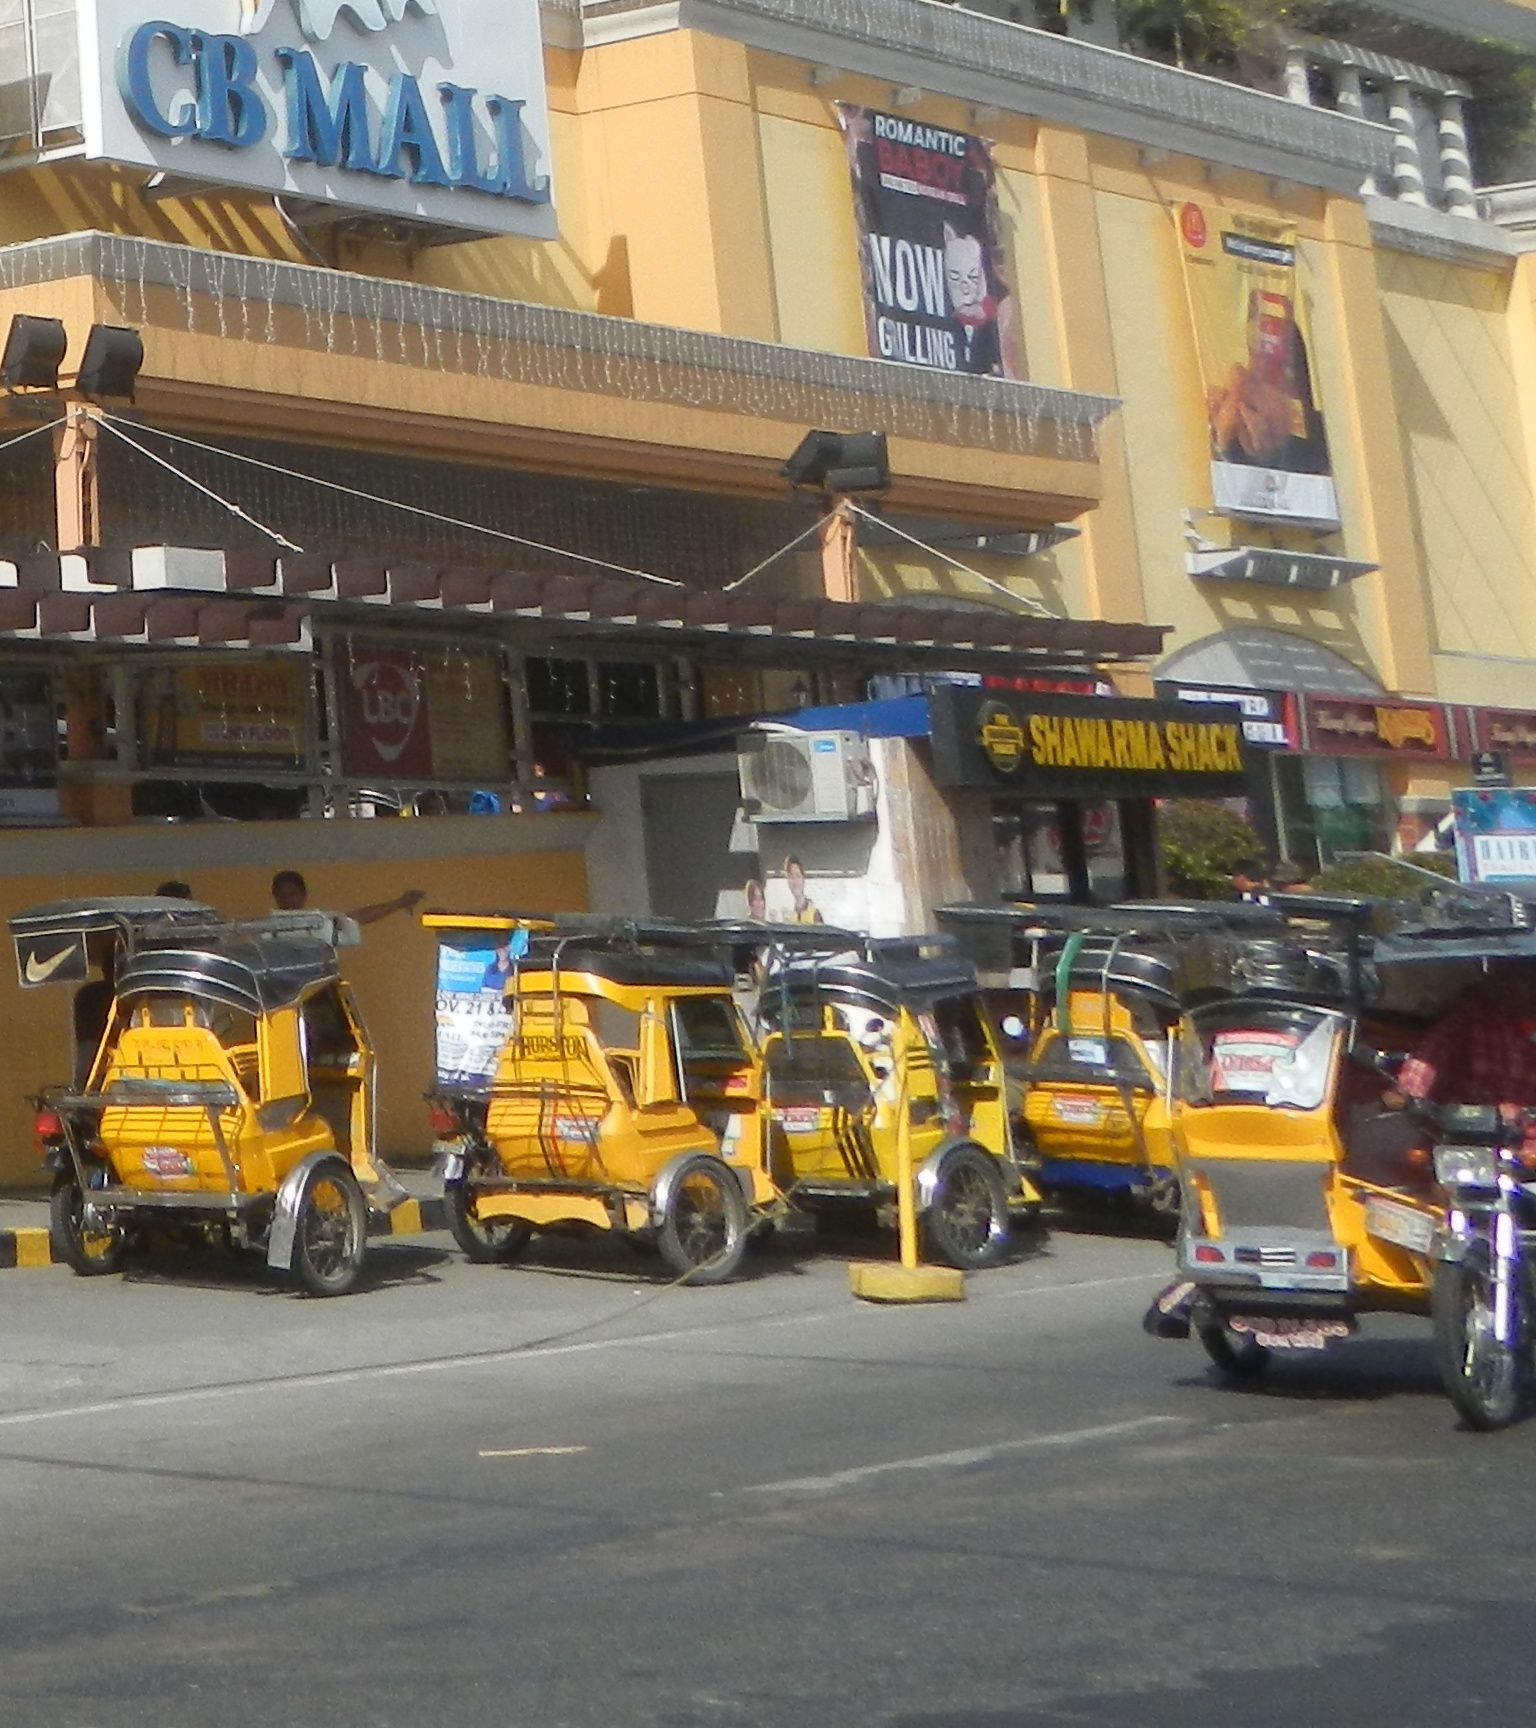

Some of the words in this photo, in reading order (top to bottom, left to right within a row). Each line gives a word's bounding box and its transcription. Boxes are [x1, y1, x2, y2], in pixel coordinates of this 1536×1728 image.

[115, 20, 267, 150] CB
[274, 47, 550, 205] MALL
[875, 114, 965, 157] ROMANTIC
[868, 232, 946, 317] NOW
[364, 690, 416, 724] LBC
[1029, 714, 1166, 770] SHAWARMA
[1166, 721, 1244, 771] SHACK
